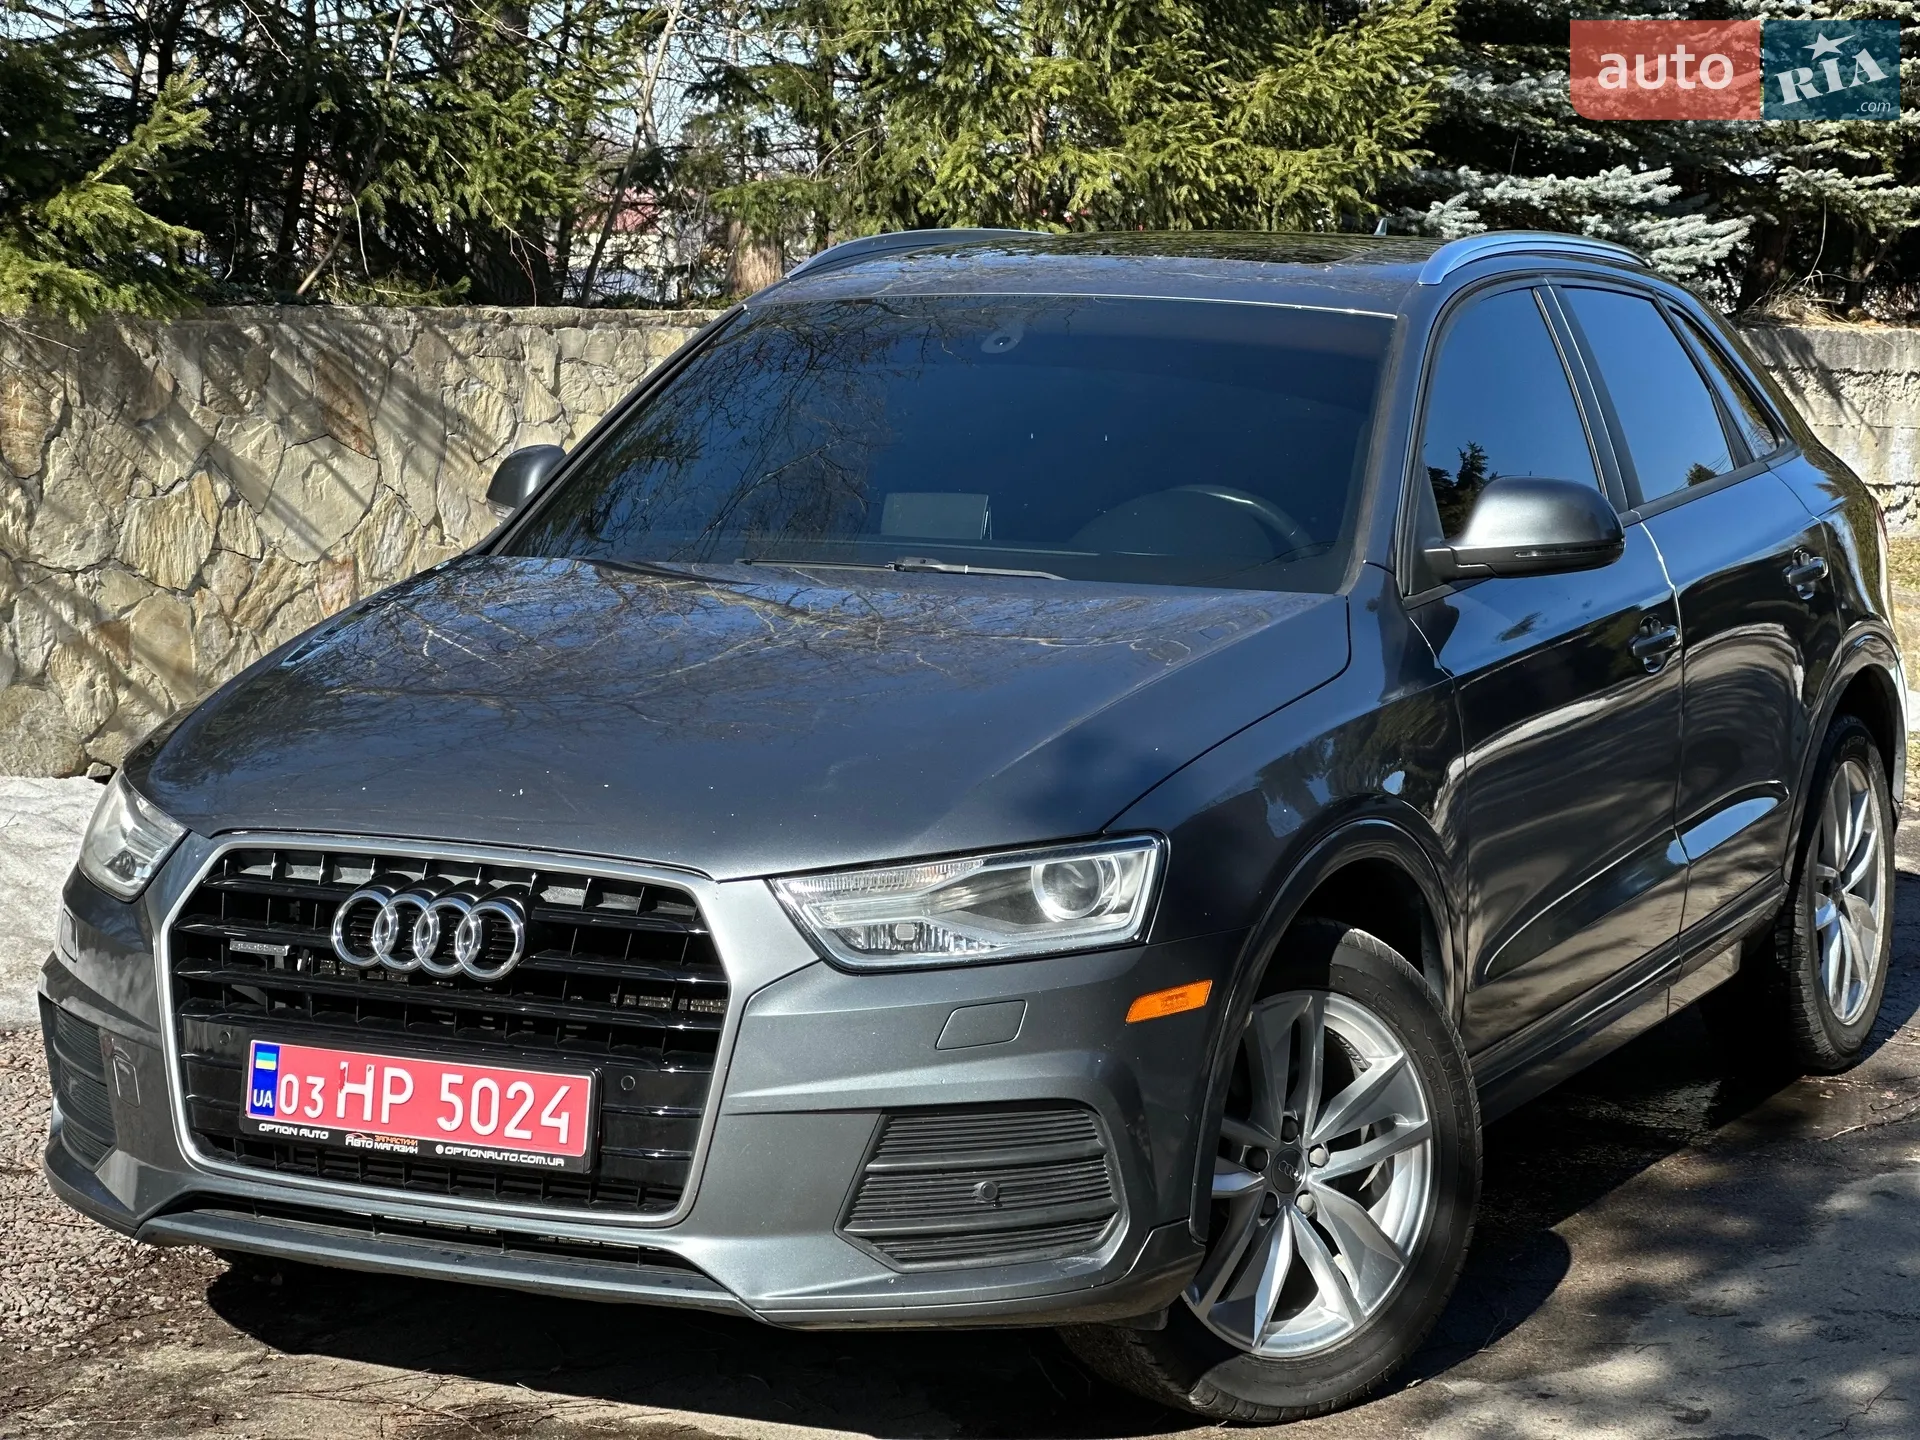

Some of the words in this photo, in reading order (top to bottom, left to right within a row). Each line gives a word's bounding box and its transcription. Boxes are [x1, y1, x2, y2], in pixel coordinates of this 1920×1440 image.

[253, 1089, 273, 1109] UA
[279, 1073, 325, 1118] 03
[336, 1061, 415, 1123] HP
[436, 1073, 571, 1144] 5024
[258, 1123, 298, 1136] OPTION
[299, 1127, 329, 1140] AUTO
